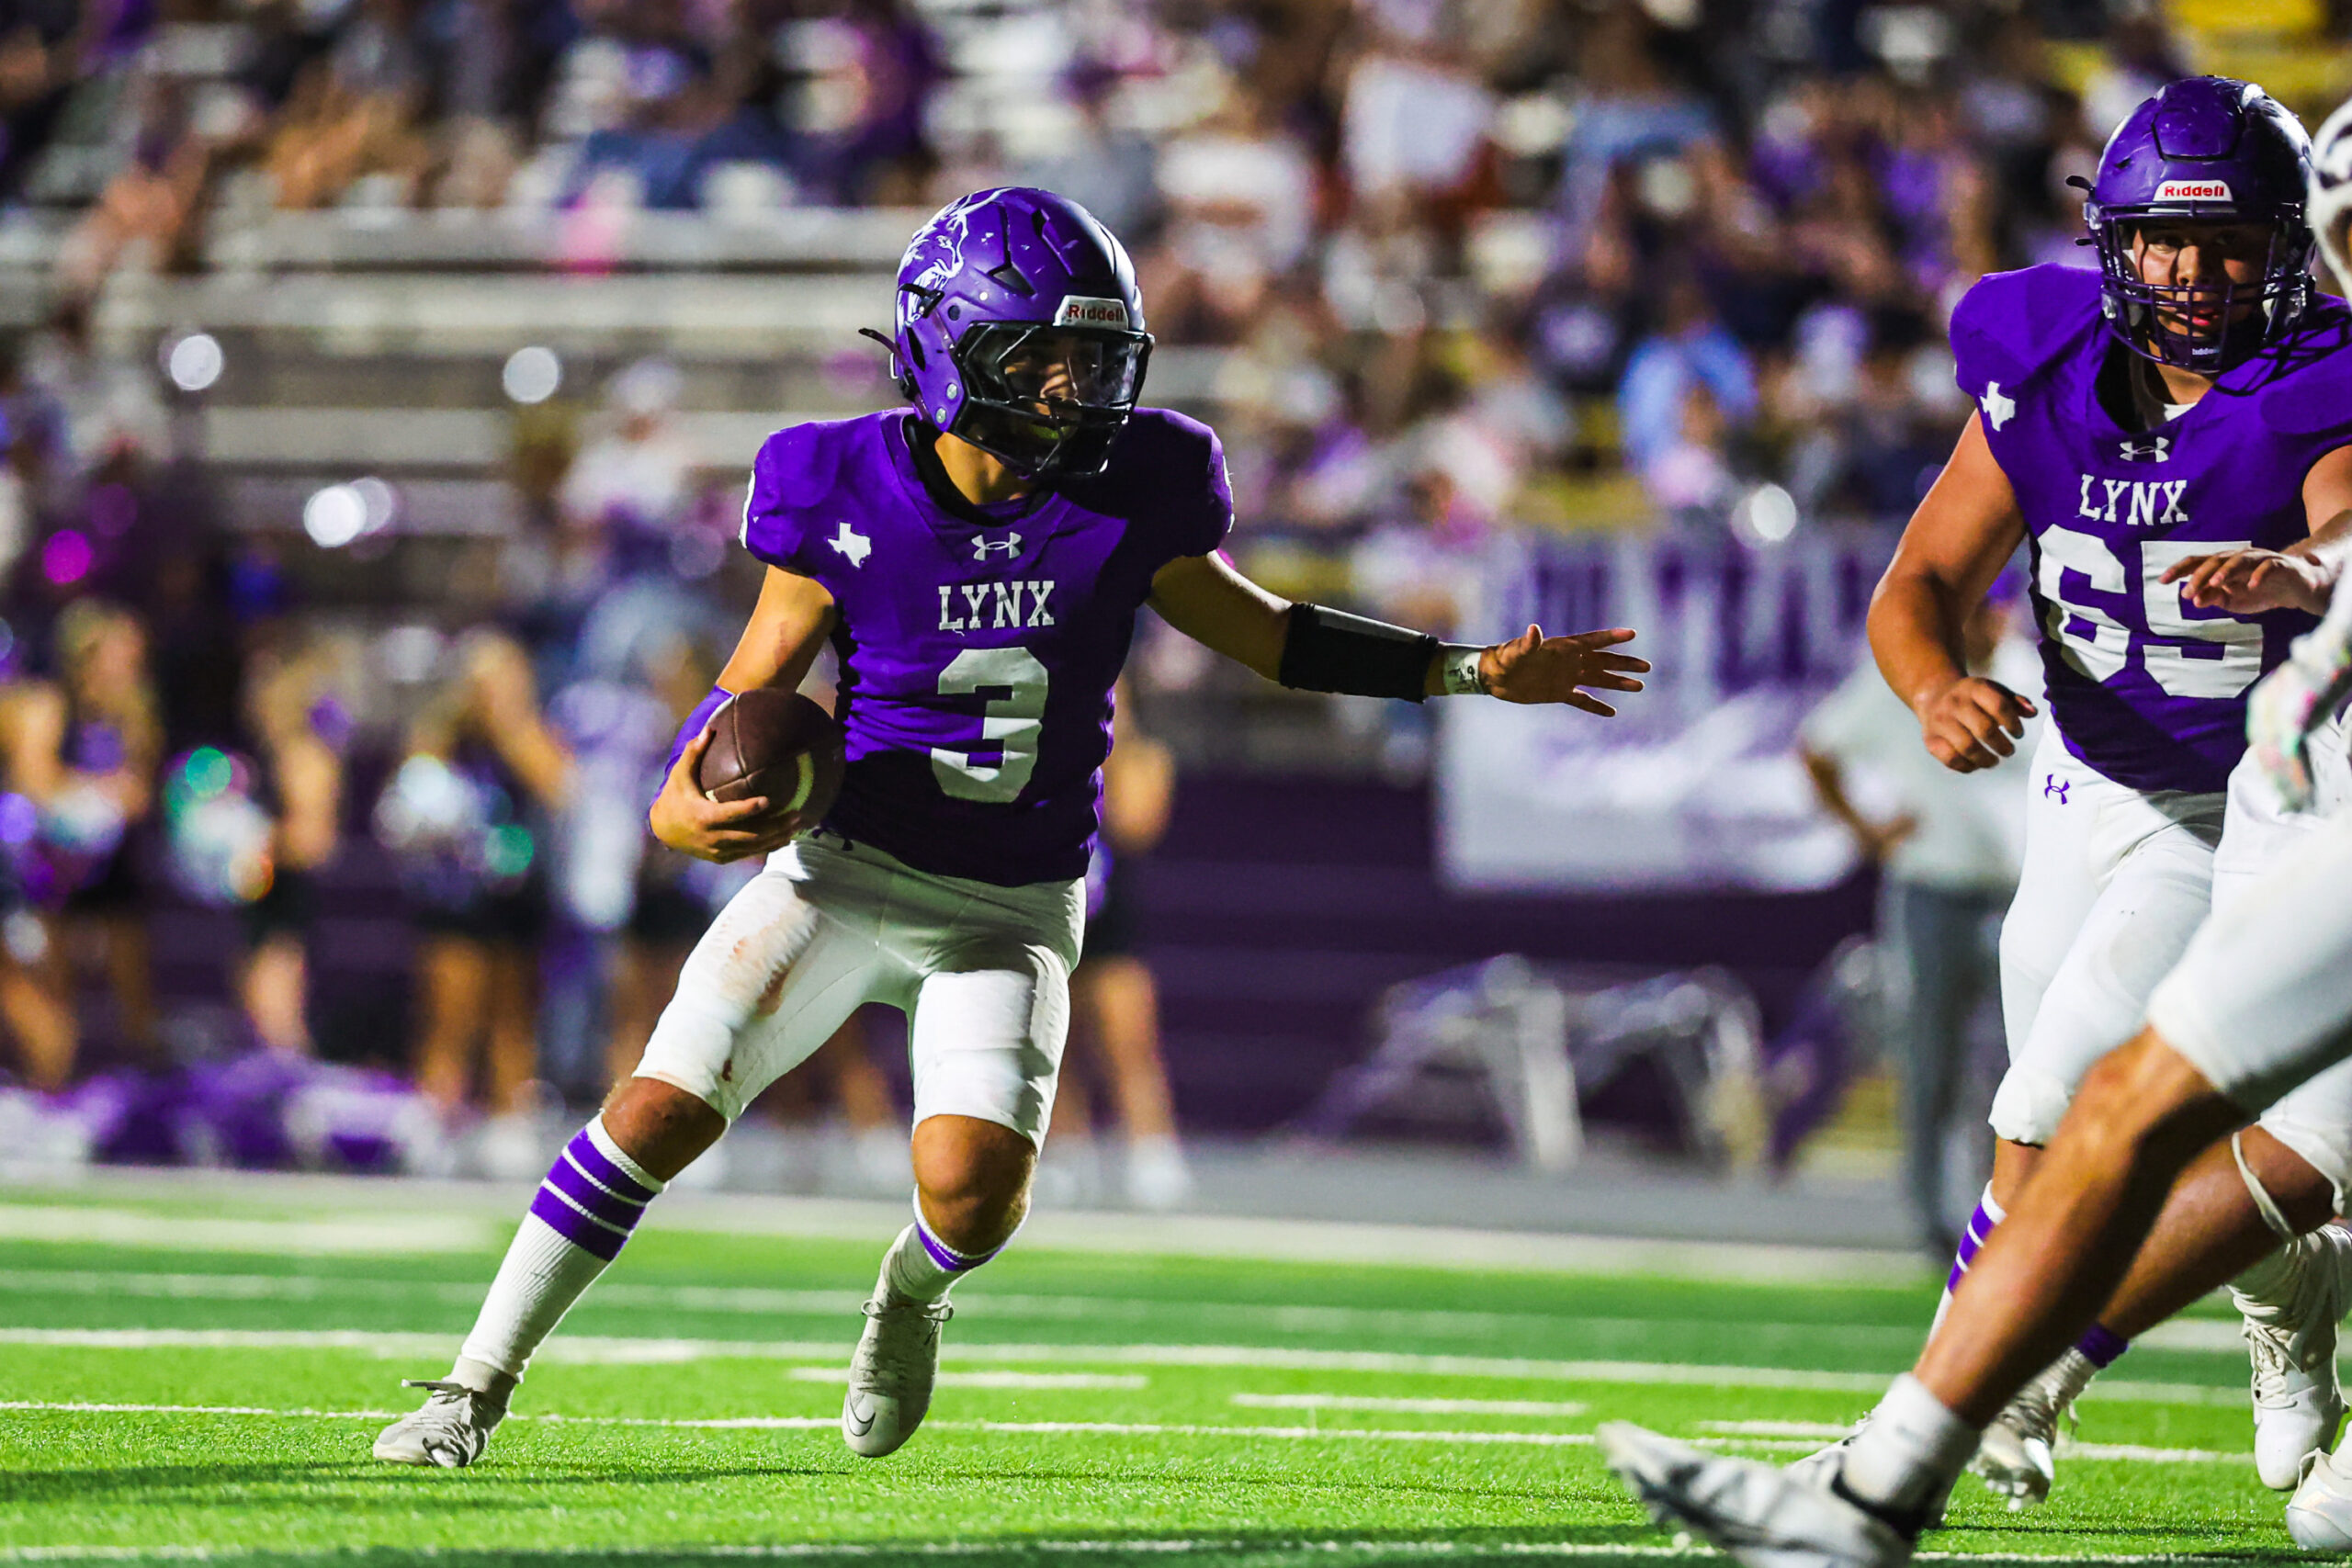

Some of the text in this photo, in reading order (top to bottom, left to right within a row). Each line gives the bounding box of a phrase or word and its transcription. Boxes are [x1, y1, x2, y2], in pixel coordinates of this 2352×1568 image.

[2165, 186, 2224, 197] Riddell
[1068, 305, 1124, 321] Riddell
[2080, 473, 2188, 526] LYNX
[938, 580, 1056, 630] LYNX
[2037, 524, 2264, 699] 65
[931, 647, 1049, 804] 3
